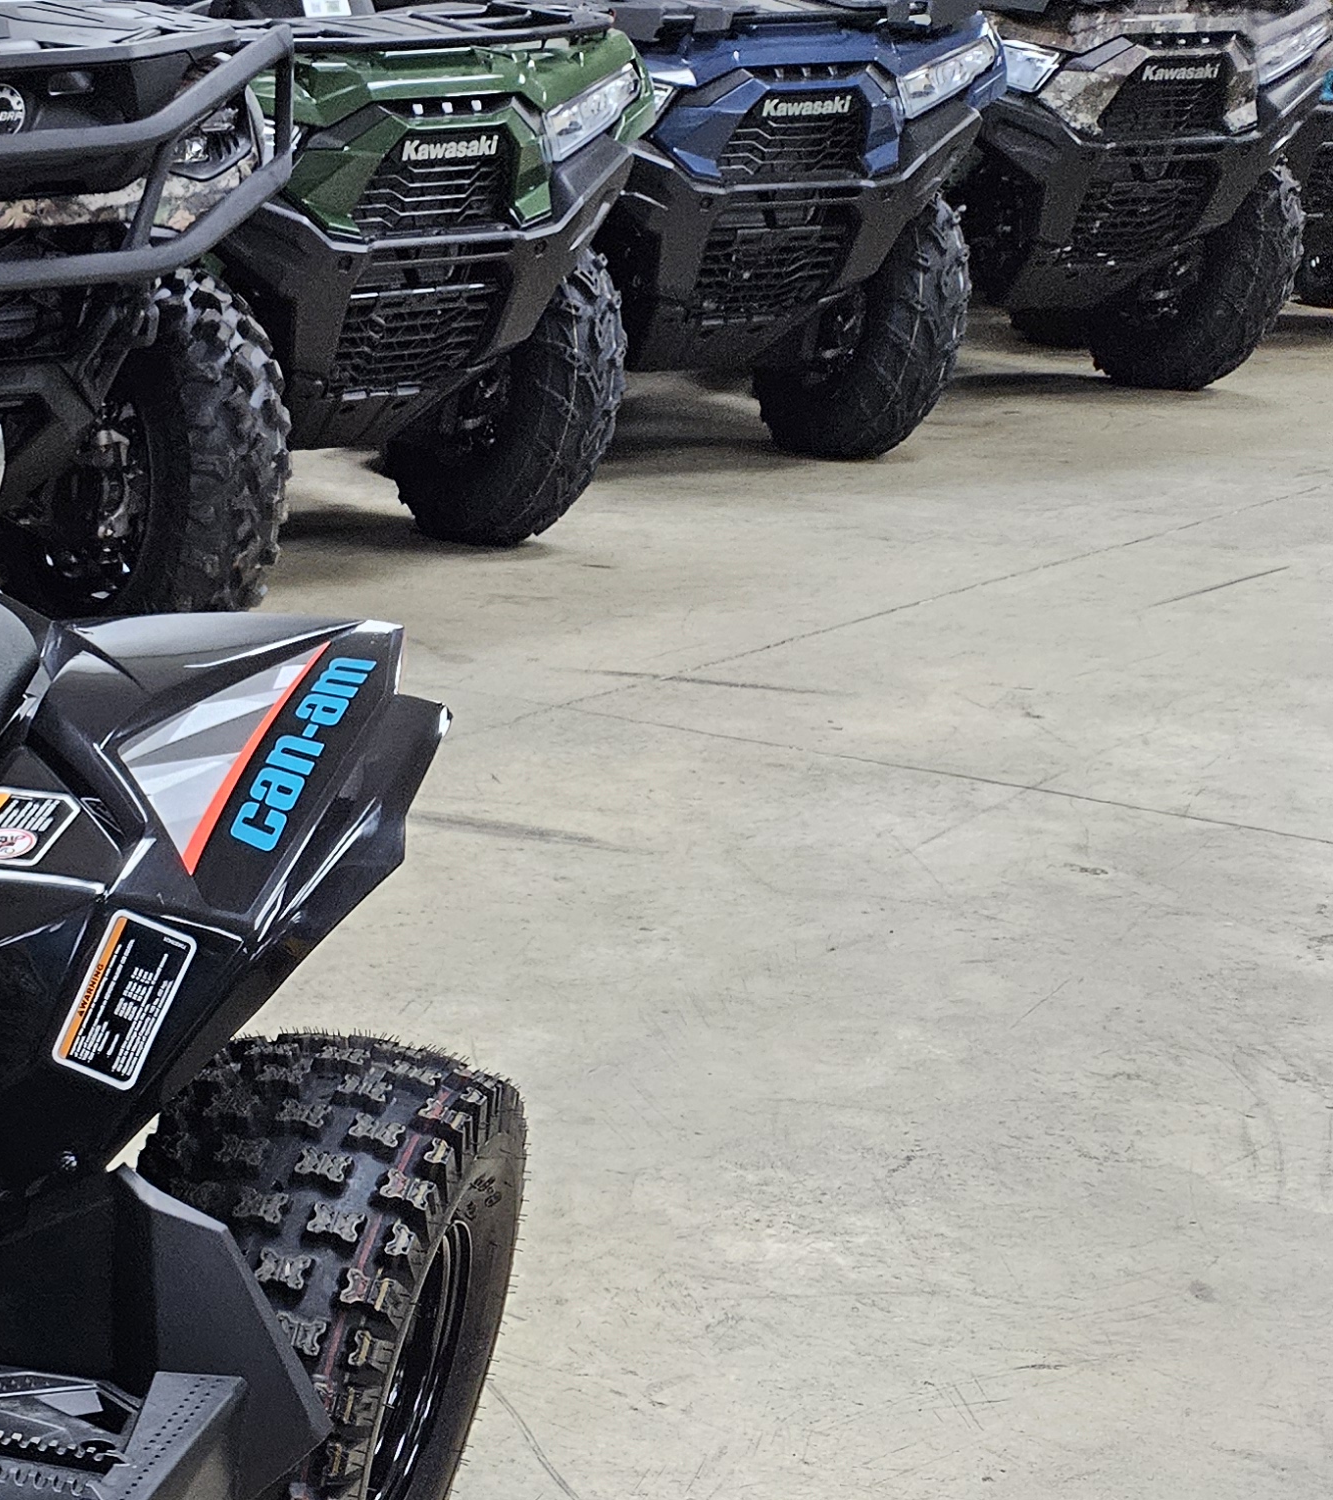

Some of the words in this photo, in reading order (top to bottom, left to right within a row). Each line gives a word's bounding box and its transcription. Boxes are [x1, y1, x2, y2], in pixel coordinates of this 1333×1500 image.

[1142, 63, 1221, 81] Kawasaki
[0, 110, 23, 122] BRP
[762, 95, 852, 117] Kawasaki
[401, 135, 499, 161] Kawasaki
[230, 657, 377, 852] can-am
[80, 963, 104, 1013] WARNING
